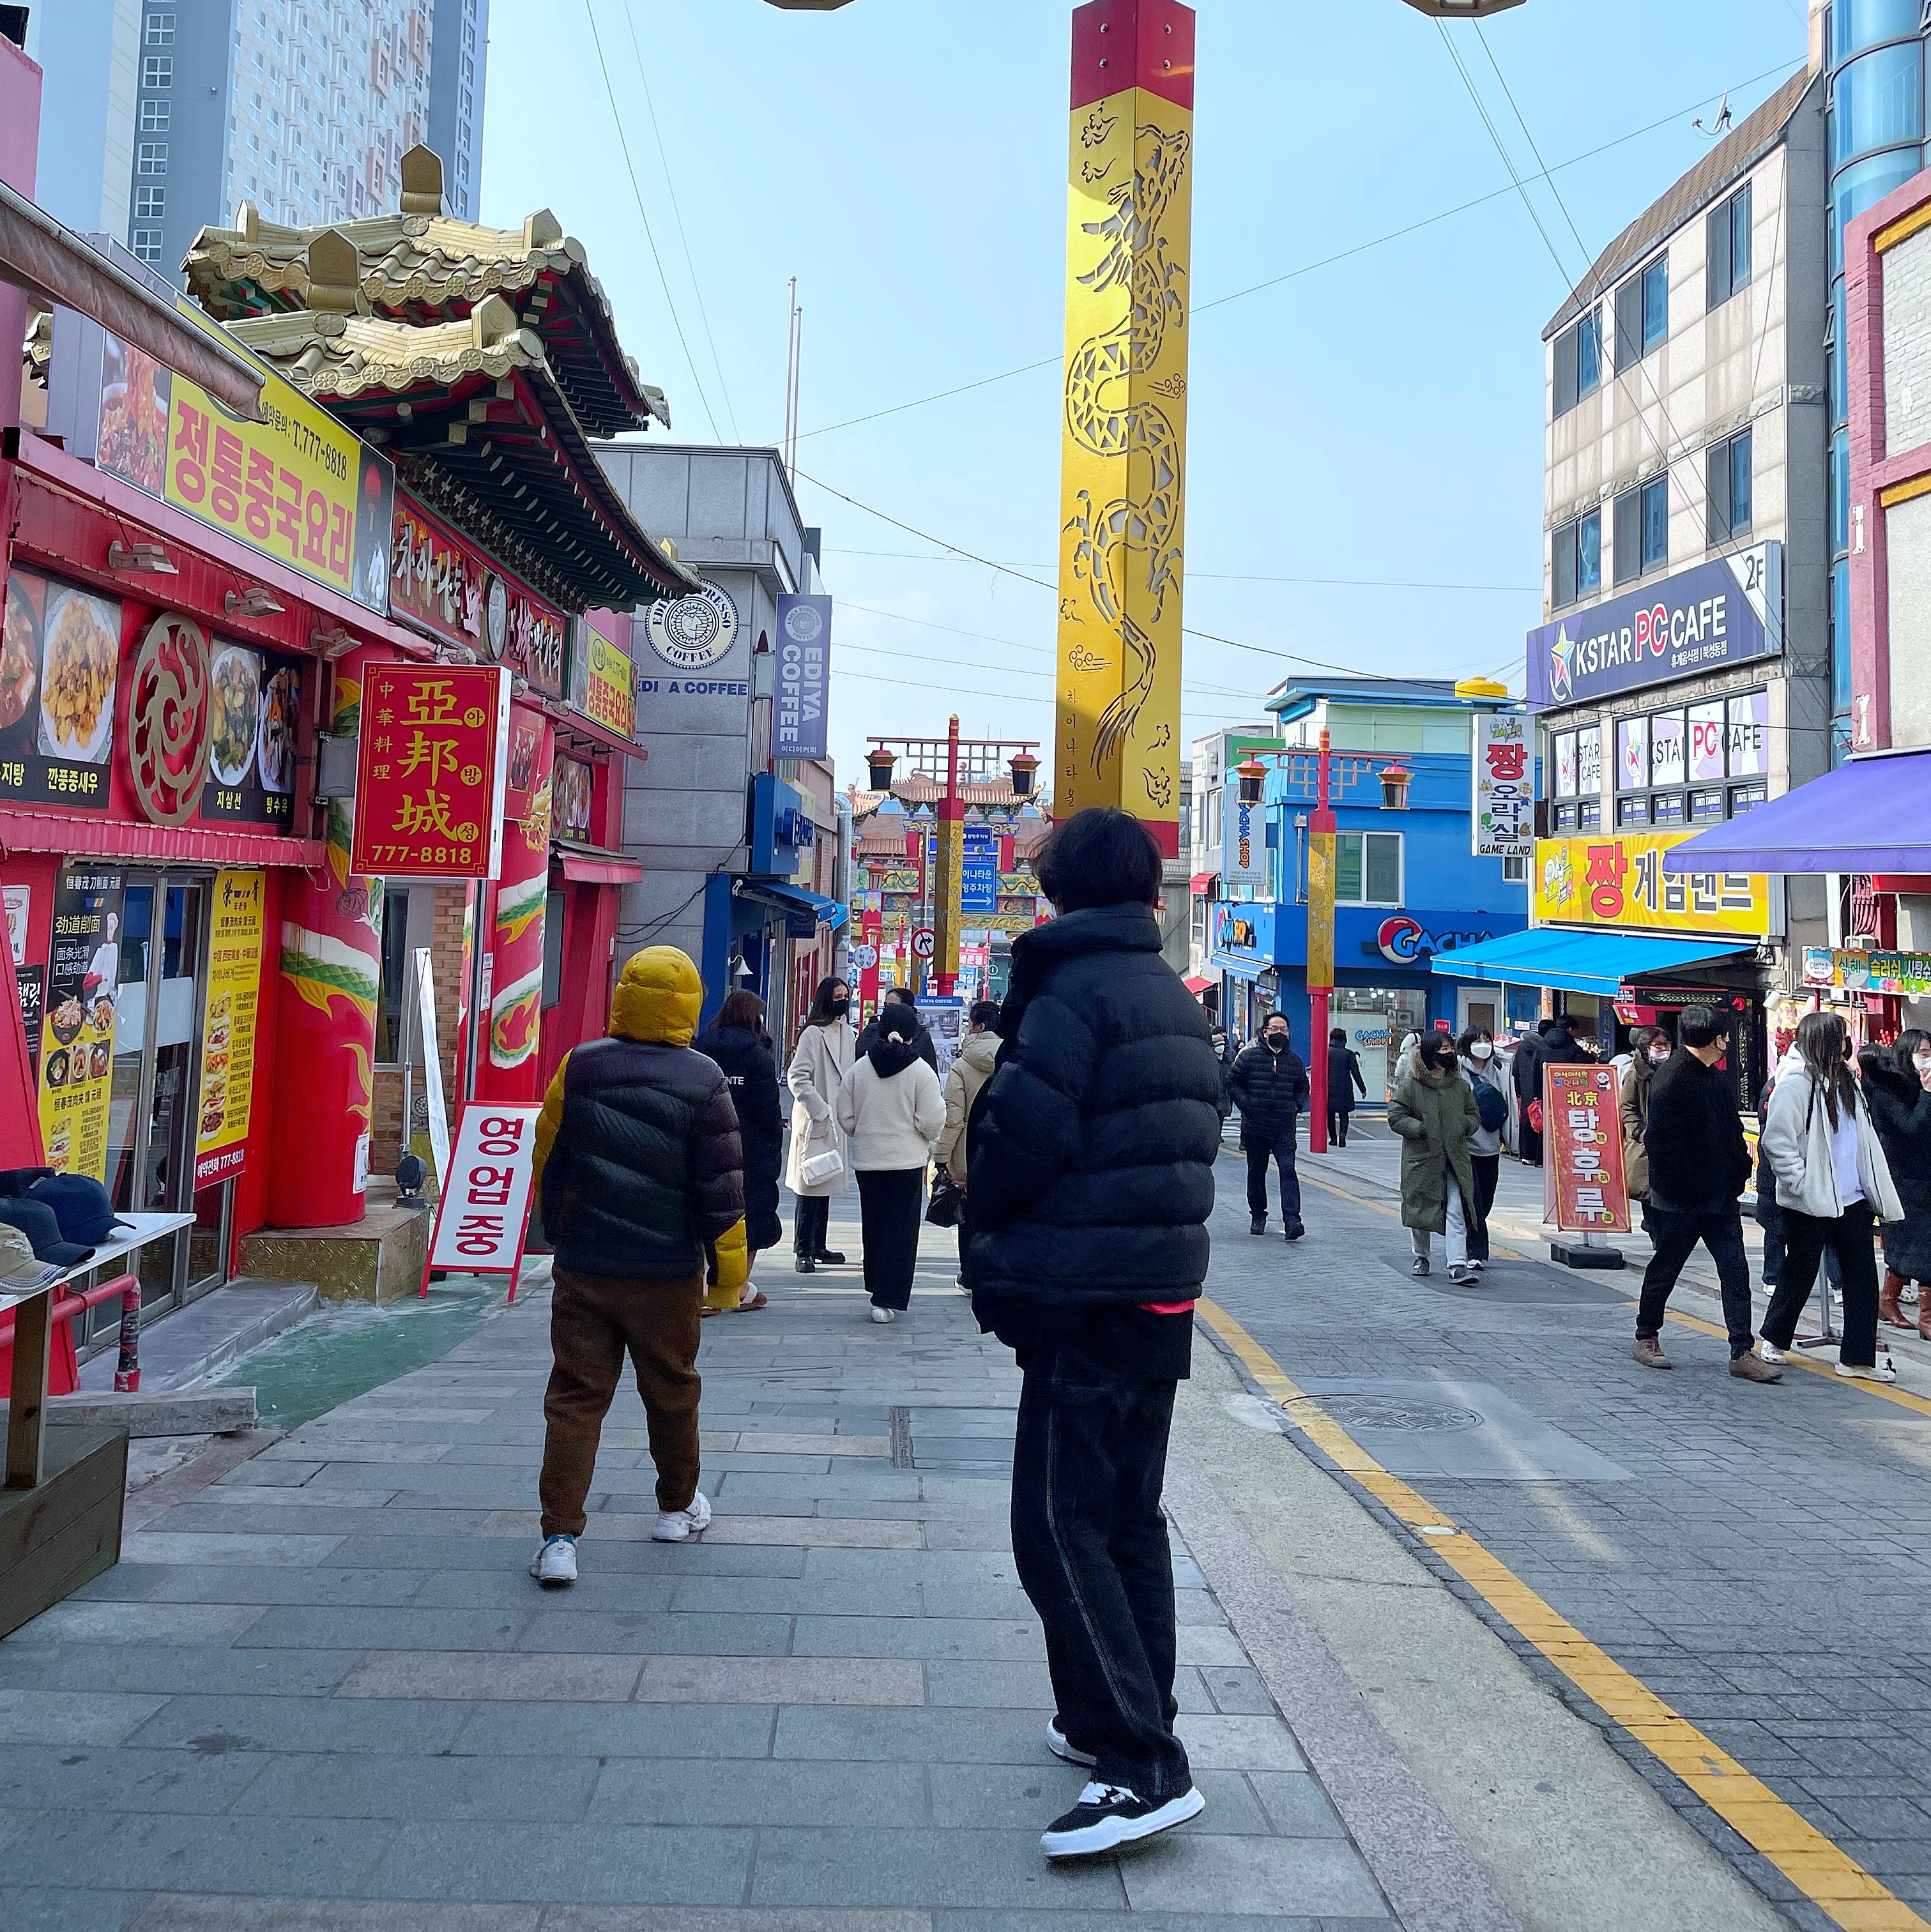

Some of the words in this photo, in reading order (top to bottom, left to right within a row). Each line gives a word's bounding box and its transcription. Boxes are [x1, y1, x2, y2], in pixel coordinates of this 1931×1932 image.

[293, 419, 347, 481] T.777-8818
[174, 398, 353, 583] 정통중국요리
[1746, 554, 1764, 591] 2F
[1576, 628, 1631, 677] KSTAR
[1634, 603, 1668, 662] PC
[1670, 595, 1727, 648] CAFE
[666, 646, 715, 662] COFFEE
[1671, 647, 1699, 668] 휴게음식점
[1703, 640, 1727, 659] 북성동점
[588, 671, 628, 732] 정통중국요리
[684, 682, 747, 696] COFFEE
[779, 644, 802, 742] COFFEE
[802, 647, 823, 722] EDIYA
[372, 681, 395, 780] 中華料理
[1693, 722, 1717, 758] PC
[392, 680, 464, 842] 亞邦城
[781, 745, 817, 754] 이디야커피
[1065, 688, 1079, 808] 차이나타운
[1485, 743, 1528, 780] 짱
[0, 762, 25, 787] 지탕
[47, 767, 98, 795] 깐풍중새우
[217, 790, 242, 810] 지삼선
[266, 796, 288, 815] 탕수육
[1490, 784, 1522, 842] 오락실
[372, 845, 471, 865] 777-8818
[1239, 838, 1250, 869] SHOP
[1479, 844, 1504, 855] GAME
[1507, 844, 1530, 855] LAND
[1585, 840, 1628, 918] 짱
[55, 915, 101, 935] 劲道削面
[1838, 956, 1861, 977] 식혜
[1870, 958, 1902, 978] 슬러쉬
[1355, 1030, 1391, 1040] GACHA
[1362, 1038, 1387, 1047] SHOP
[1566, 1090, 1599, 1106] 北京
[197, 1153, 220, 1178] 예약전화
[220, 1148, 245, 1169] 777-8818
[1568, 1108, 1607, 1222] 탕후루
[455, 1116, 524, 1256] 영업중
